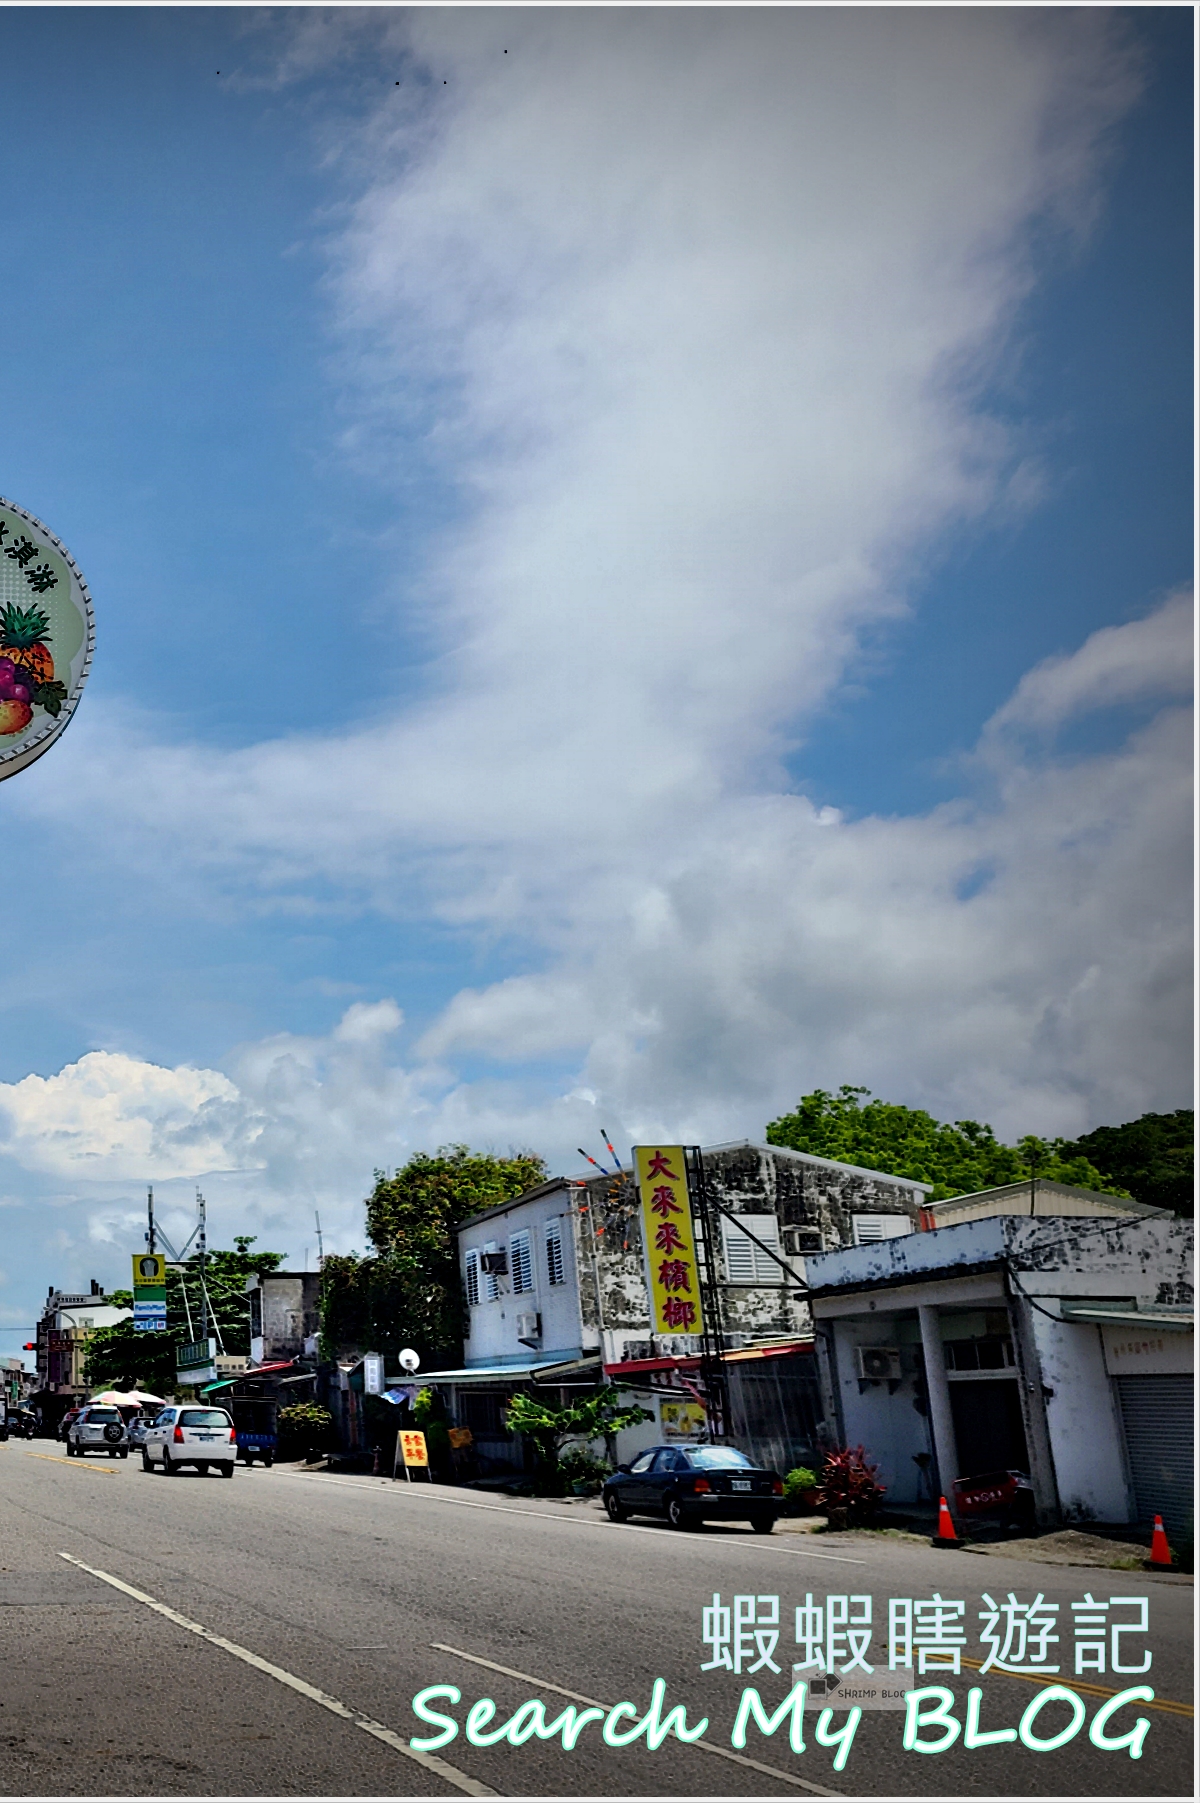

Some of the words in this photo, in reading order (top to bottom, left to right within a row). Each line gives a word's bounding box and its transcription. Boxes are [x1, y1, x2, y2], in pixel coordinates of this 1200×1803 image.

[646, 1150, 697, 1333] 大來來檳榔
